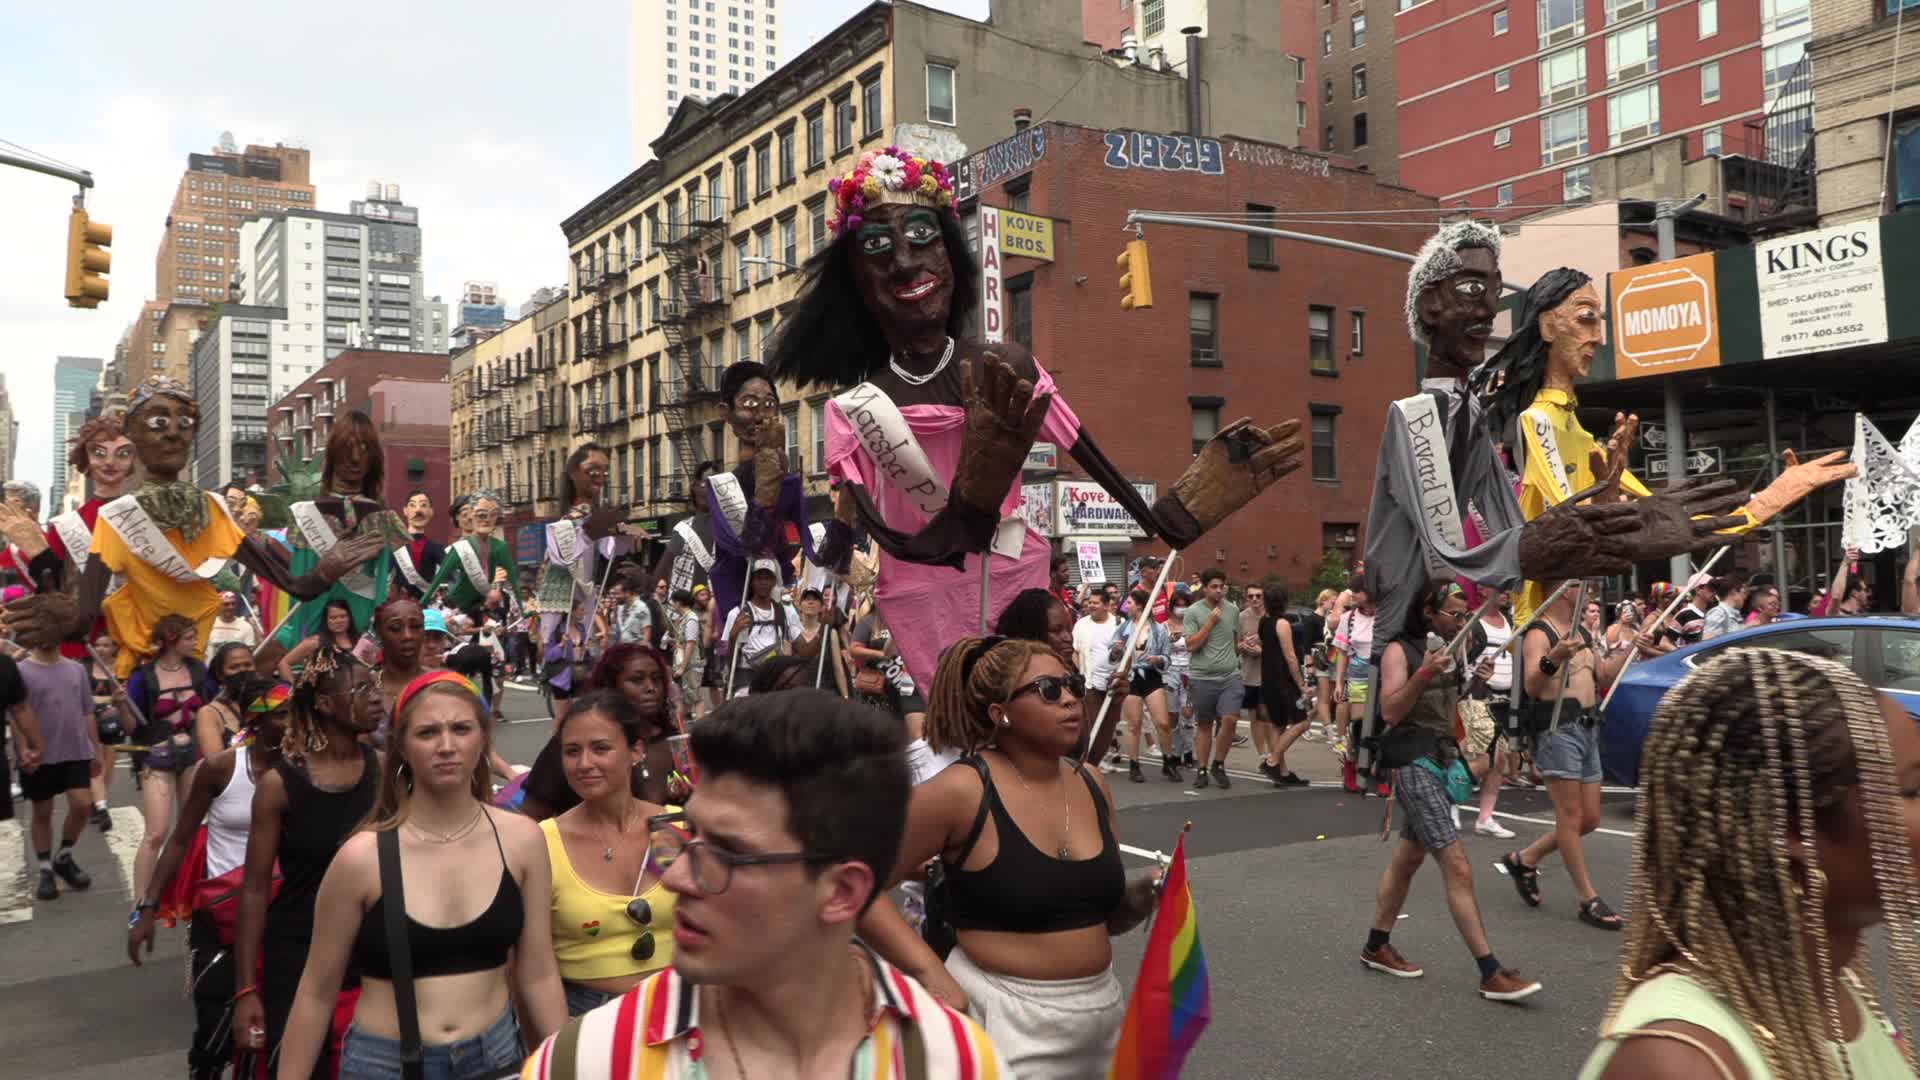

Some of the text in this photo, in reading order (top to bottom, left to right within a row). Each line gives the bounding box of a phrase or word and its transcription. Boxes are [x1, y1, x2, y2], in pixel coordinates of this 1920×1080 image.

[1007, 216, 1044, 233] KOVE
[1006, 235, 1046, 253] BROS.
[1767, 231, 1869, 274] KINGS
[983, 213, 1001, 344] HARD
[1767, 283, 1873, 308] SHED SCAFFOLD HOIST
[1625, 301, 1702, 336] MOMOYA
[1780, 332, 1809, 343] (917)
[846, 383, 909, 479] Marsha
[1070, 487, 1104, 503] Kove
[1072, 506, 1137, 520] HARDWAR
[109, 506, 154, 558] Alice
[1080, 560, 1100, 569] BLACK
